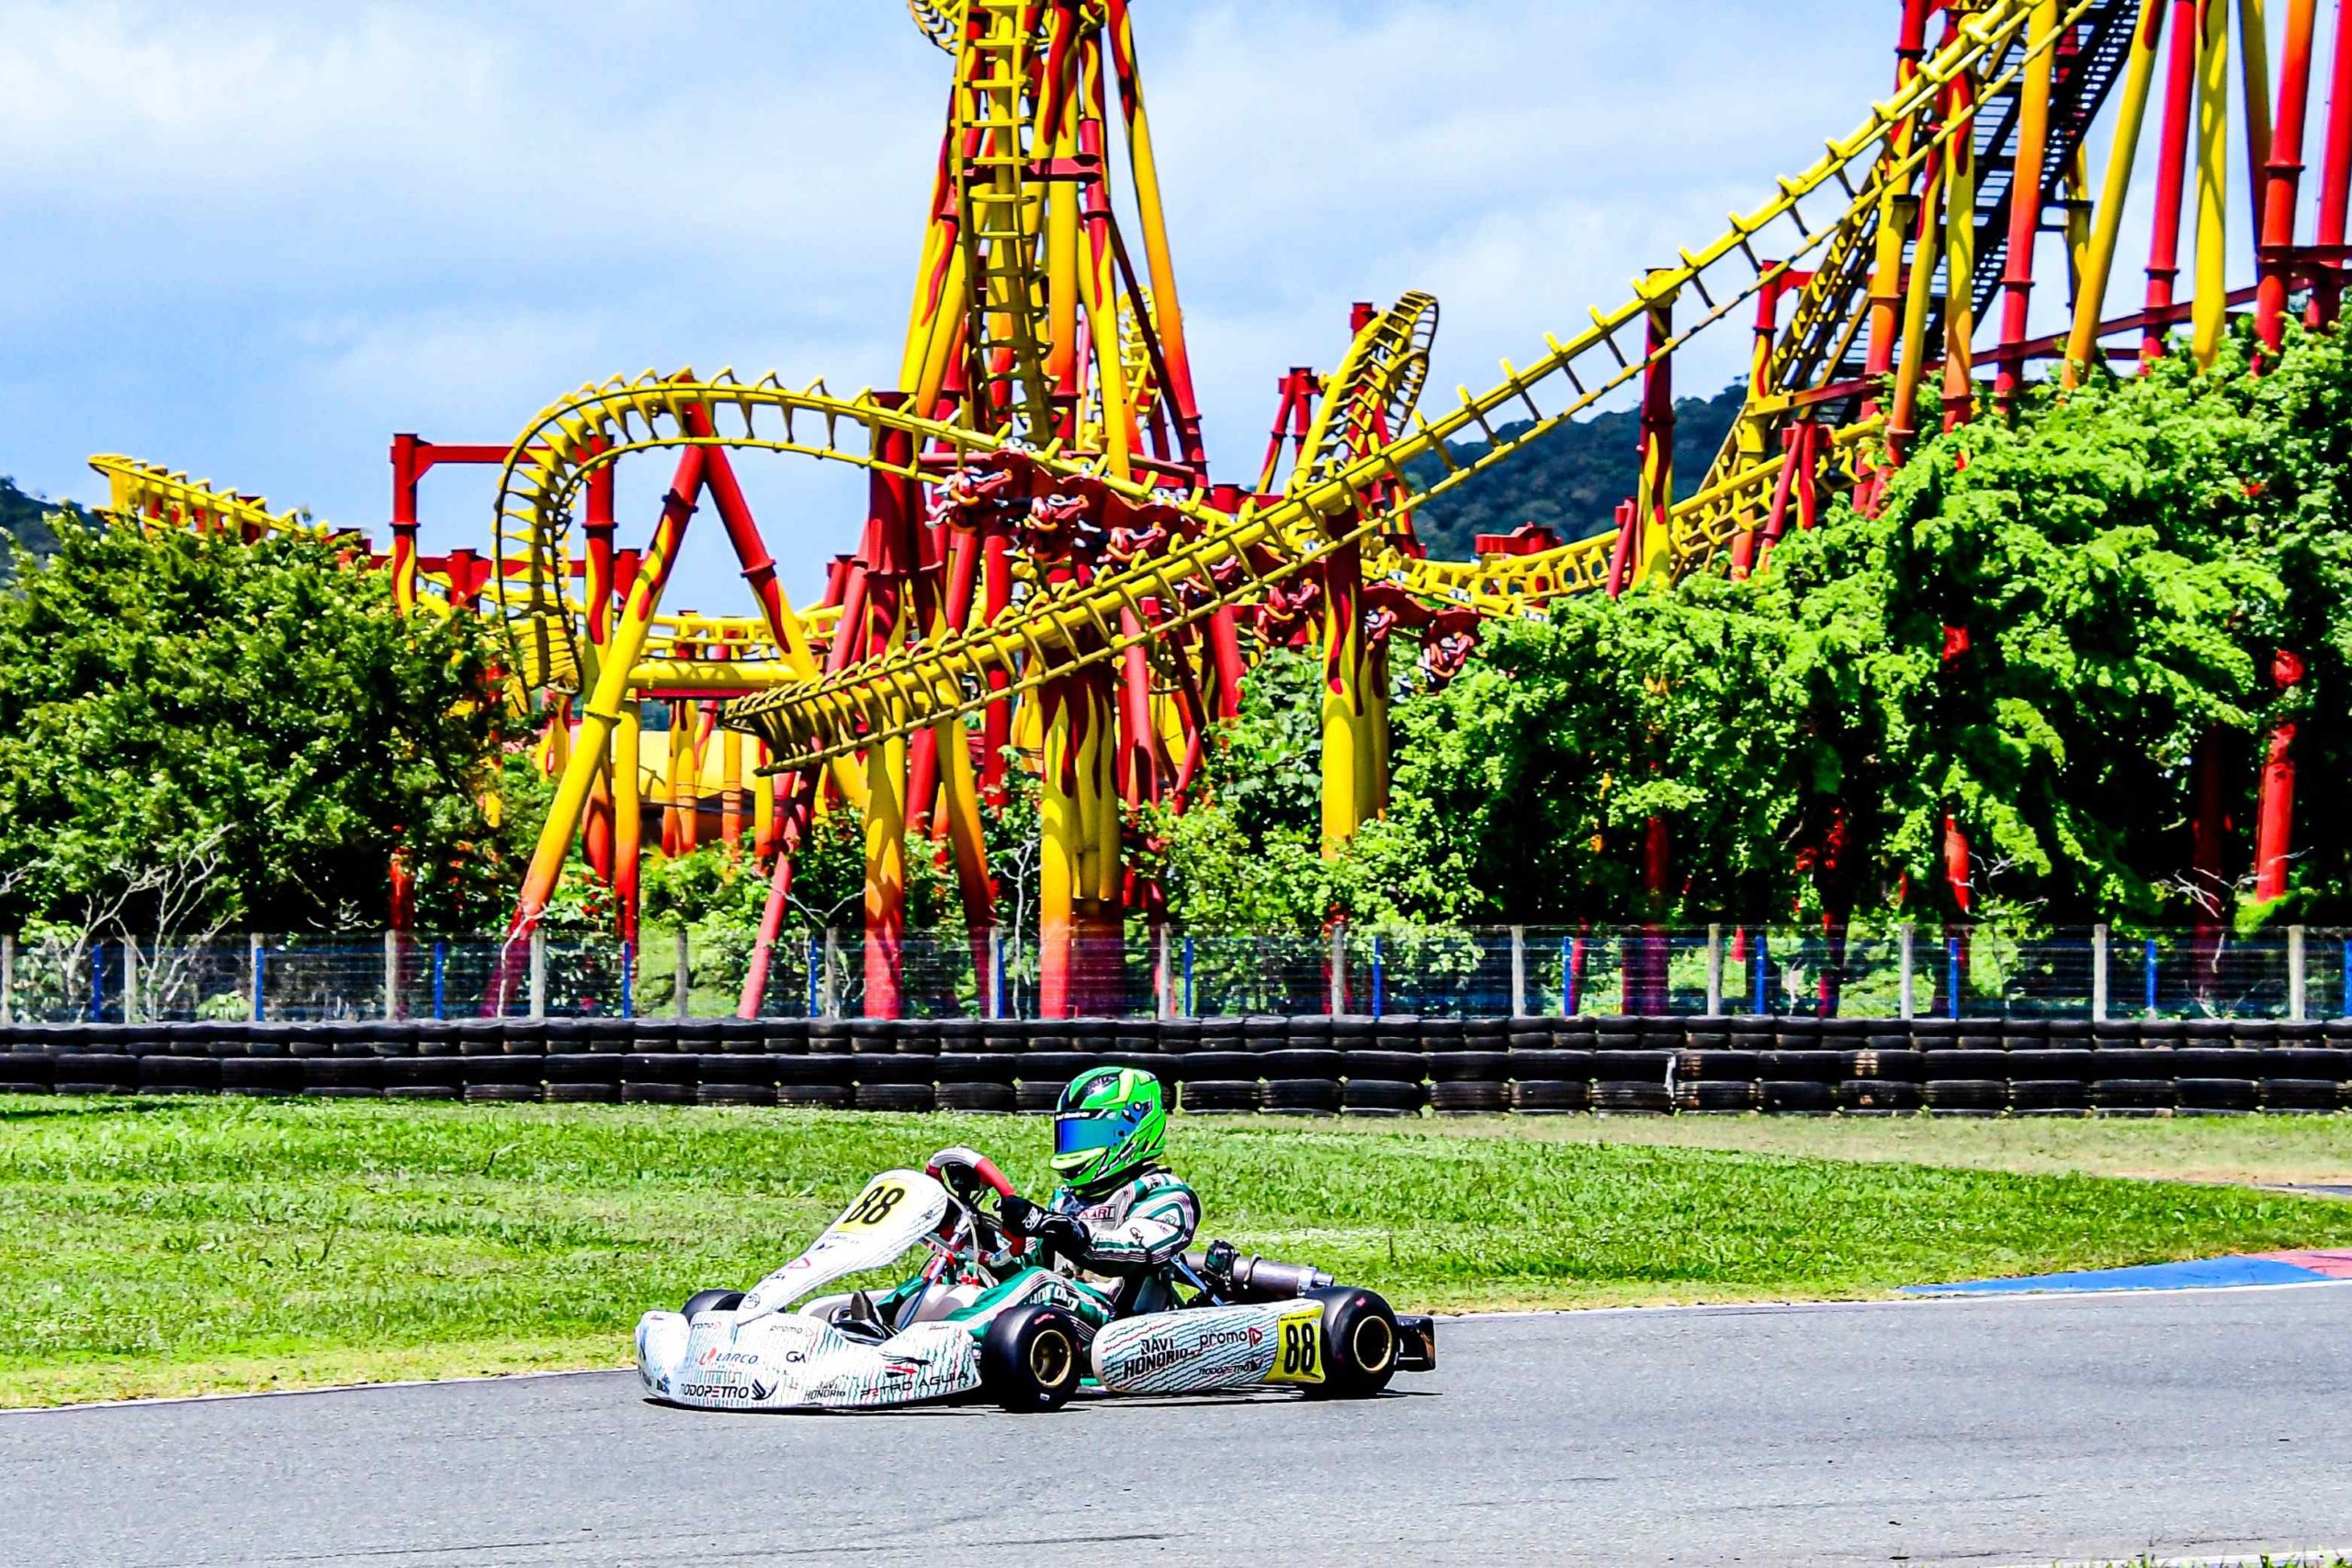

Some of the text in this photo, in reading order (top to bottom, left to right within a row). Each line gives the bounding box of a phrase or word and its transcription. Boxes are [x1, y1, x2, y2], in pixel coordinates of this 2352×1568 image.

[842, 1185, 906, 1224] 88
[716, 1352, 759, 1364] LARCO
[1140, 1337, 1174, 1355] DAVI
[1283, 1323, 1316, 1374] 88
[1124, 1348, 1189, 1379] HONORIO
